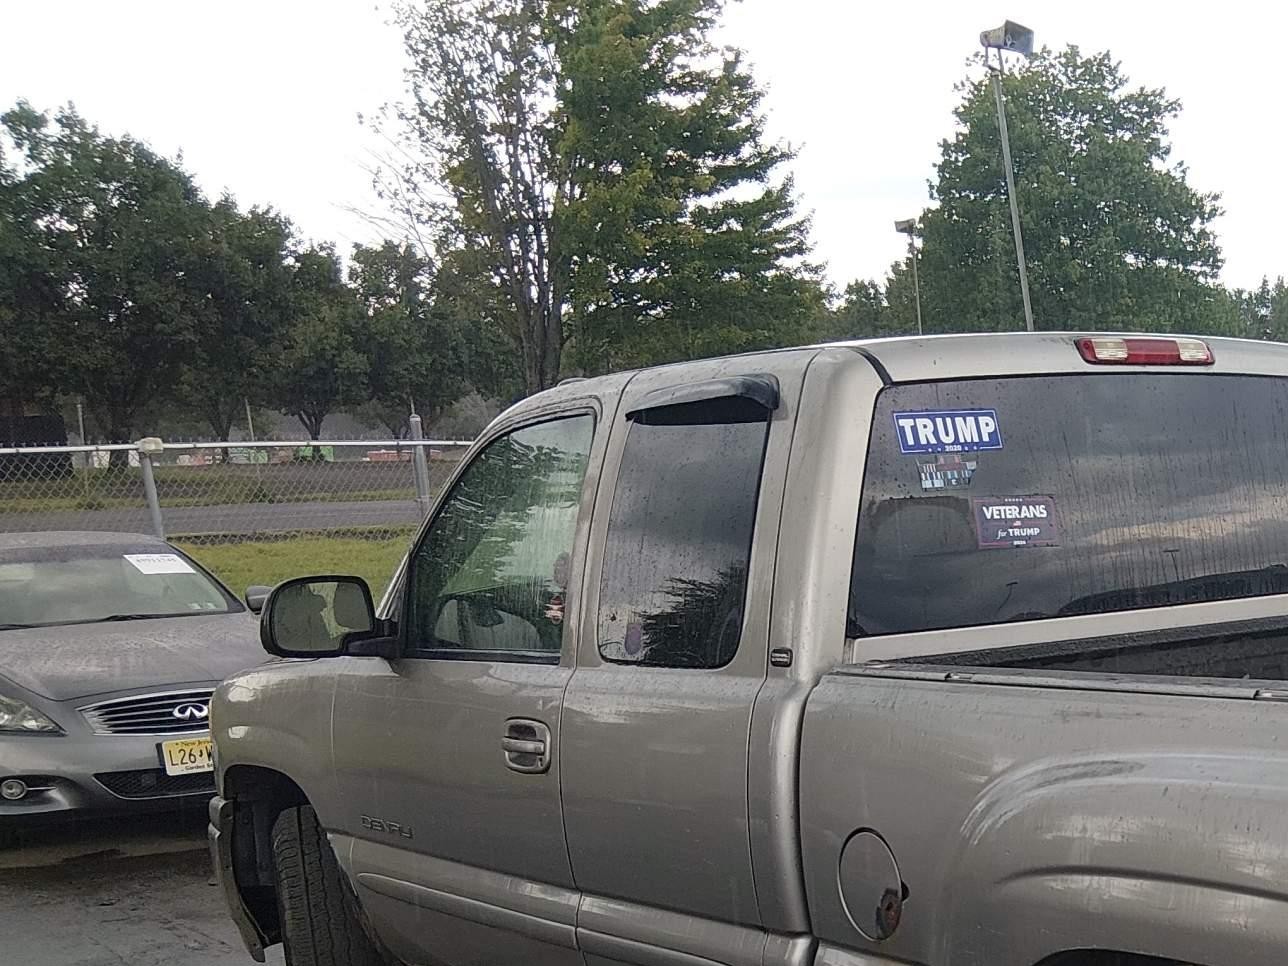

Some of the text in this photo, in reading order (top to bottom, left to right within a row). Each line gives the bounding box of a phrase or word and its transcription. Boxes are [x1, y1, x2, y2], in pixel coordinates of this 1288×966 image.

[898, 416, 995, 446] TRUMP
[945, 444, 962, 452] 2020
[982, 504, 1048, 520] VETERANS
[996, 527, 1040, 540] for TRUMP
